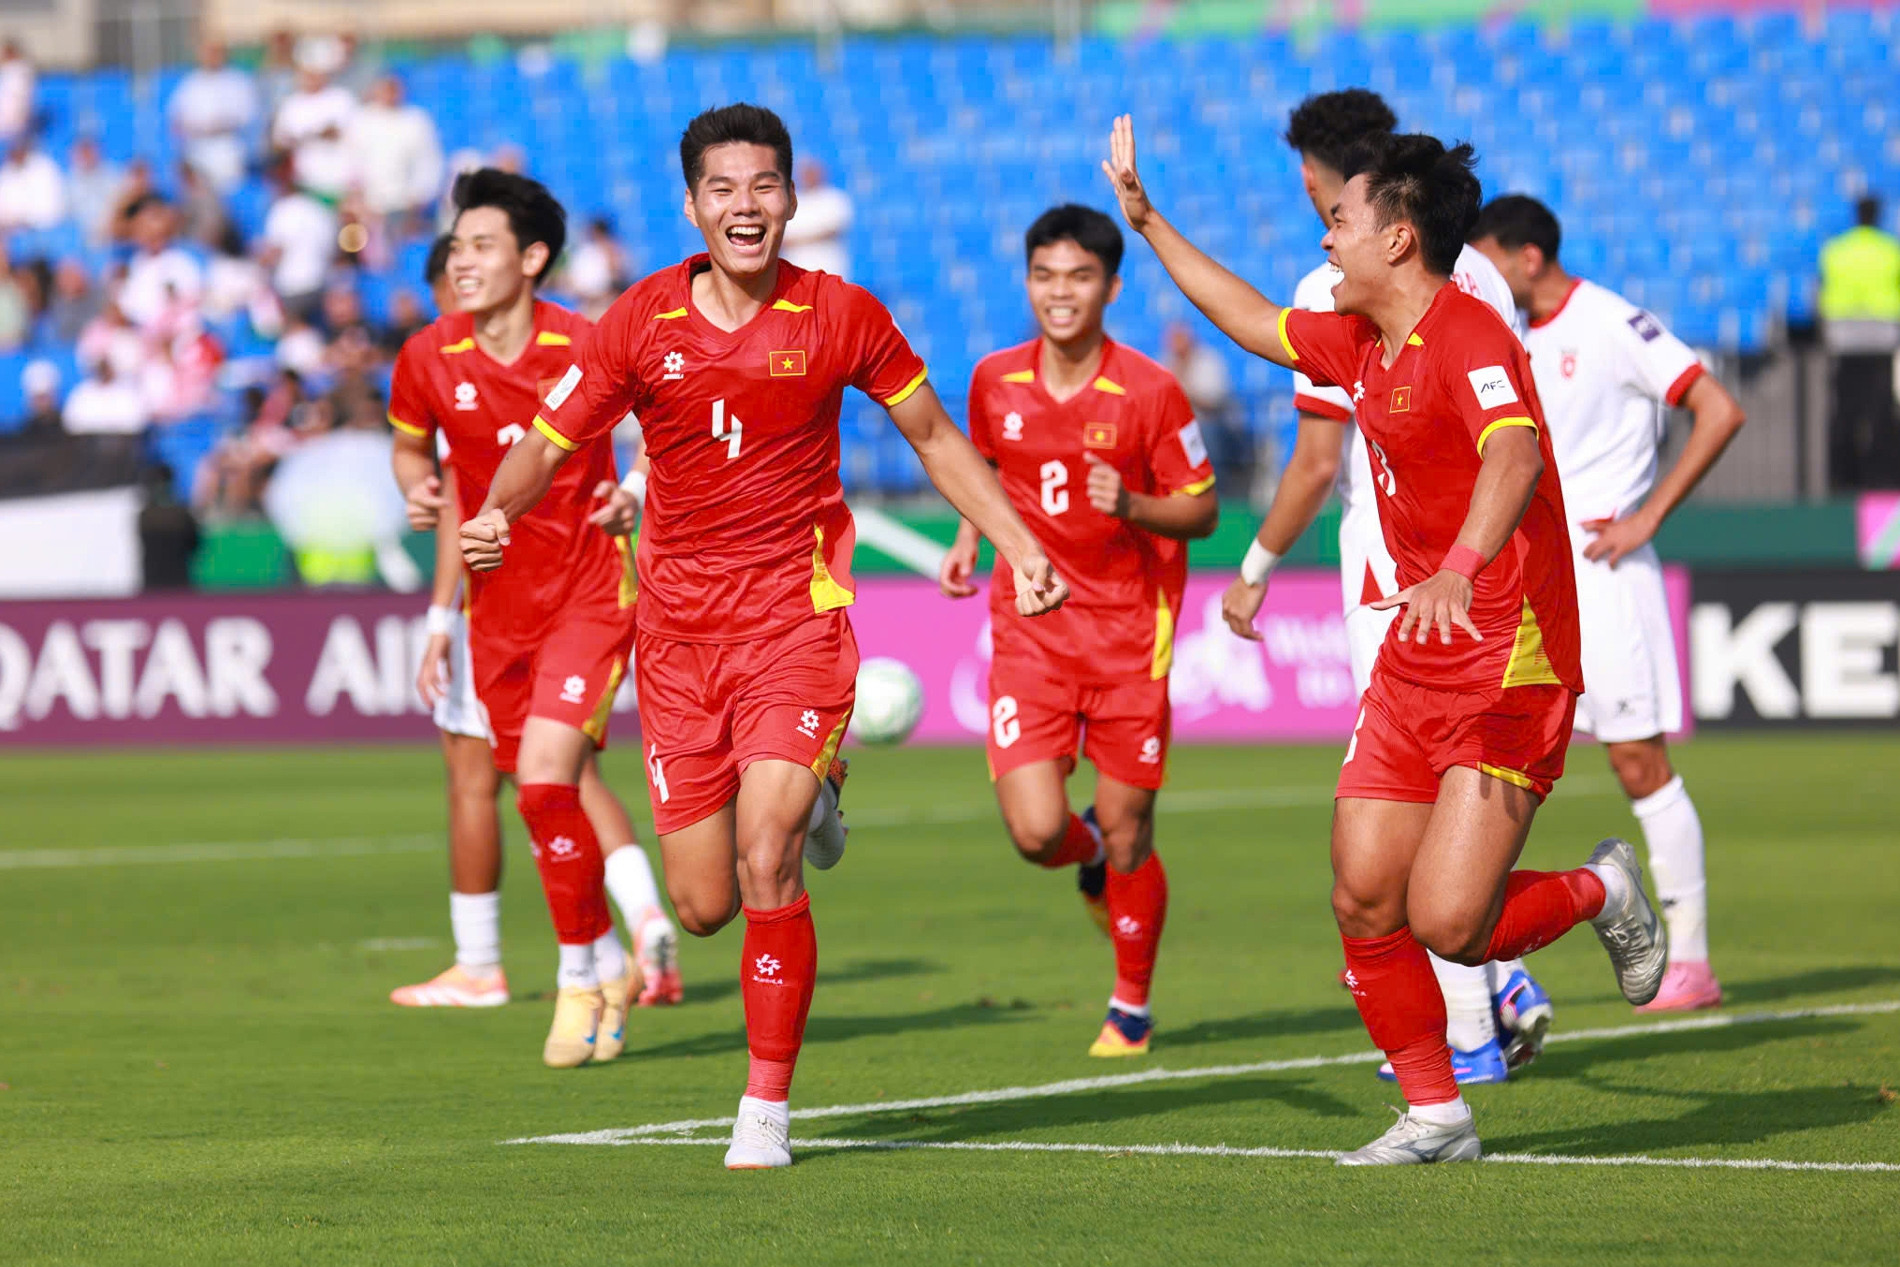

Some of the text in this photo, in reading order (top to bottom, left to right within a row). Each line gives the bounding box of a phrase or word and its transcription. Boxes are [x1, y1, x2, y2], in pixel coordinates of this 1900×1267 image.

[1480, 379, 1505, 393] AFC
[712, 398, 743, 459] 4
[1040, 459, 1069, 516] 2
[992, 695, 1021, 749] 2
[648, 742, 670, 804] 4
